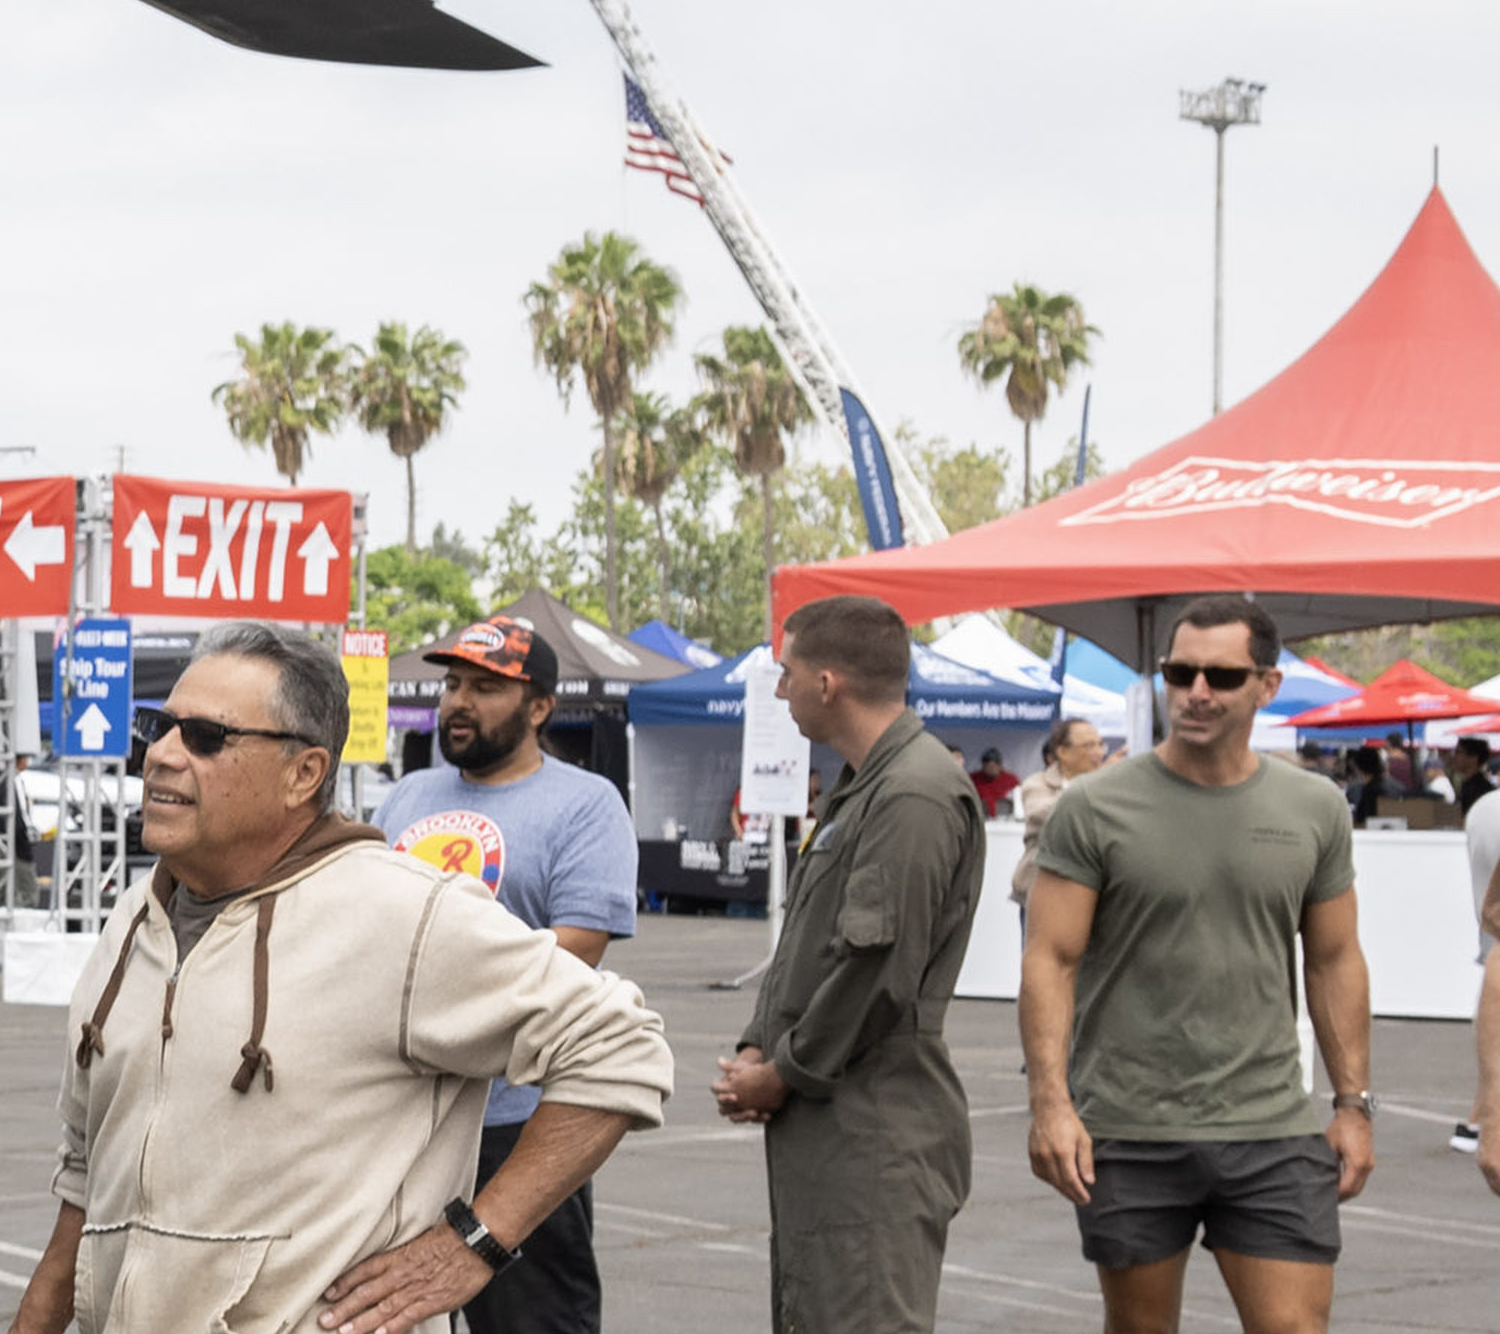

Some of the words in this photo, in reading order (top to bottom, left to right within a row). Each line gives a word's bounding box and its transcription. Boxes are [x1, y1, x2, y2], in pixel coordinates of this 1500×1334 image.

[1124, 464, 1481, 507] Budweiser
[162, 494, 303, 602] EXIT
[345, 635, 386, 655] NOTICE
[95, 657, 127, 678] Tour
[77, 679, 109, 699] Line
[707, 699, 743, 716] navy
[402, 814, 499, 852] BROOKLYN
